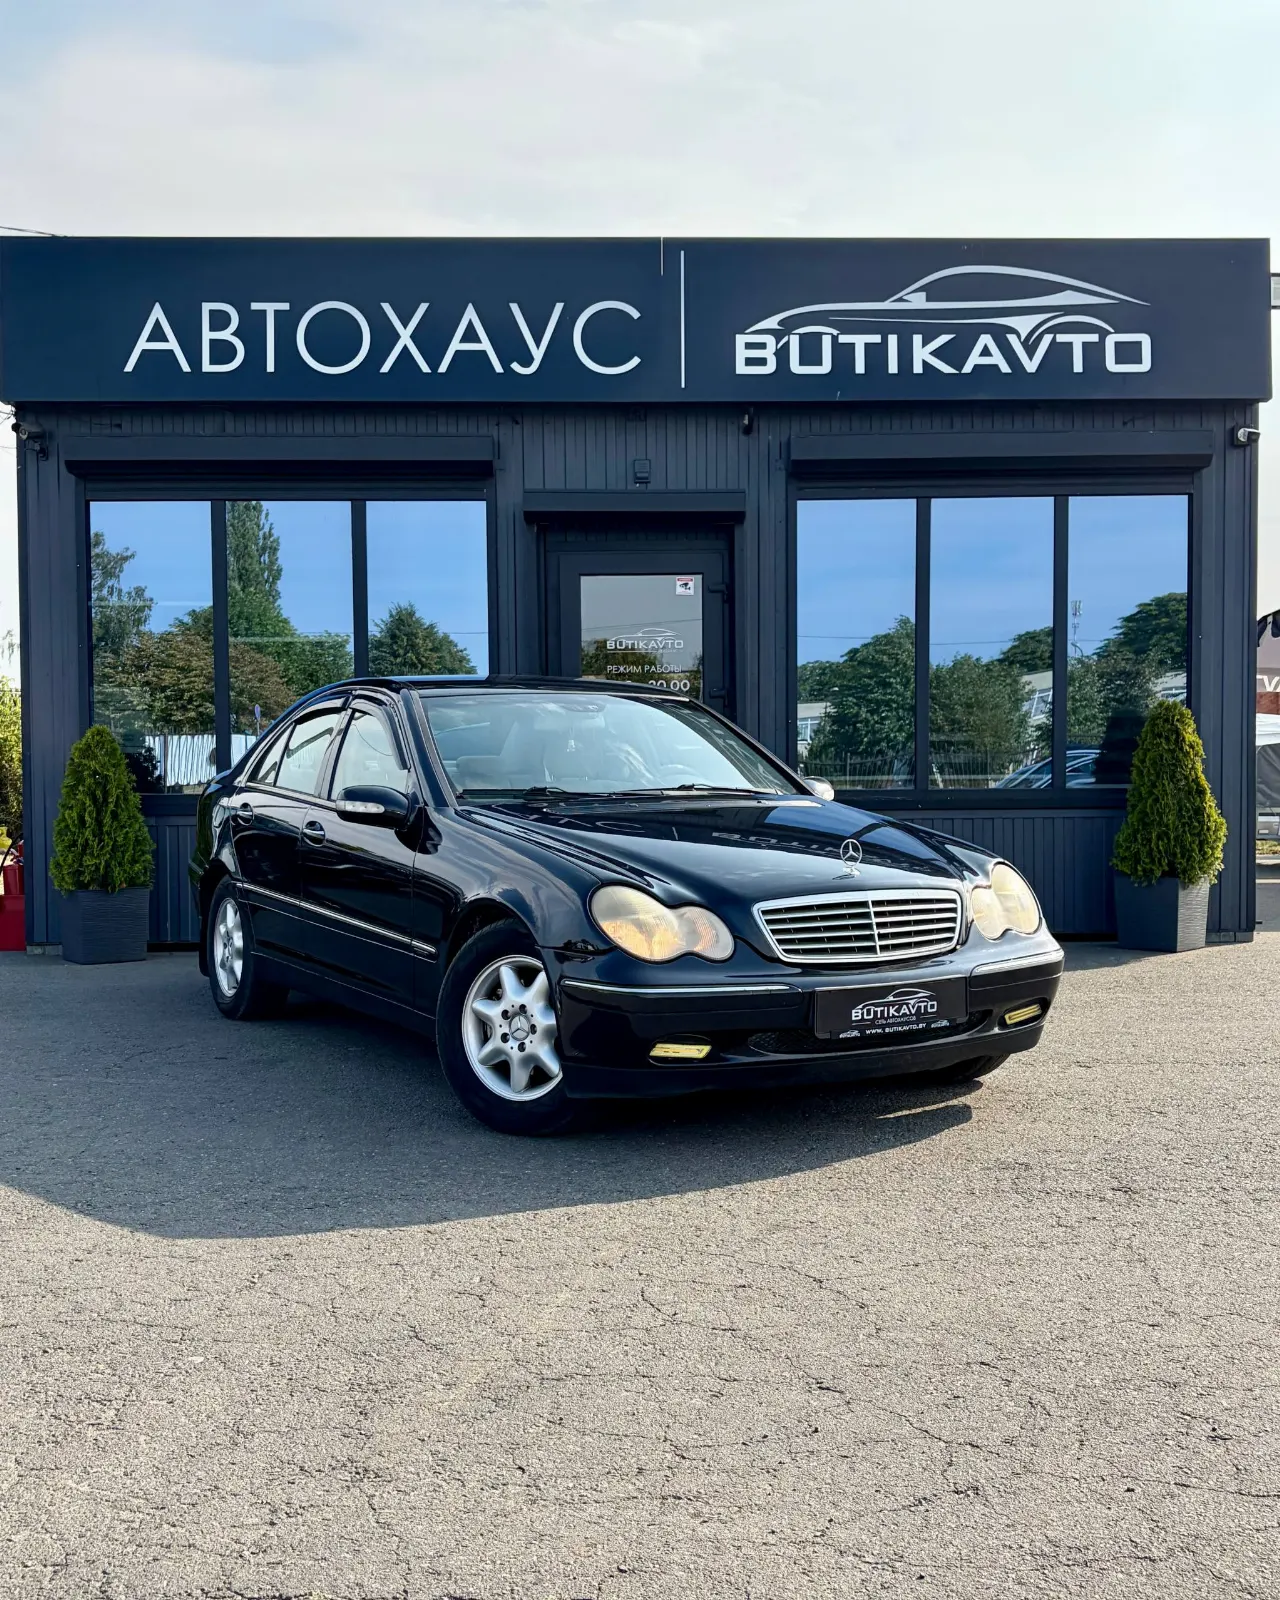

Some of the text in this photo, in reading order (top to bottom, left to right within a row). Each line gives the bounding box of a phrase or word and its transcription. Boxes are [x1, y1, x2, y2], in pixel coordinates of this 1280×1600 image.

[123, 300, 642, 375] АВТОХАУС
[735, 332, 1152, 375] BUTIKAVTO
[606, 639, 684, 650] BUTIKAVTO
[606, 664, 682, 674] РЕЖИМ РАБОТЫ
[851, 1001, 938, 1021] BUTIKAVTO
